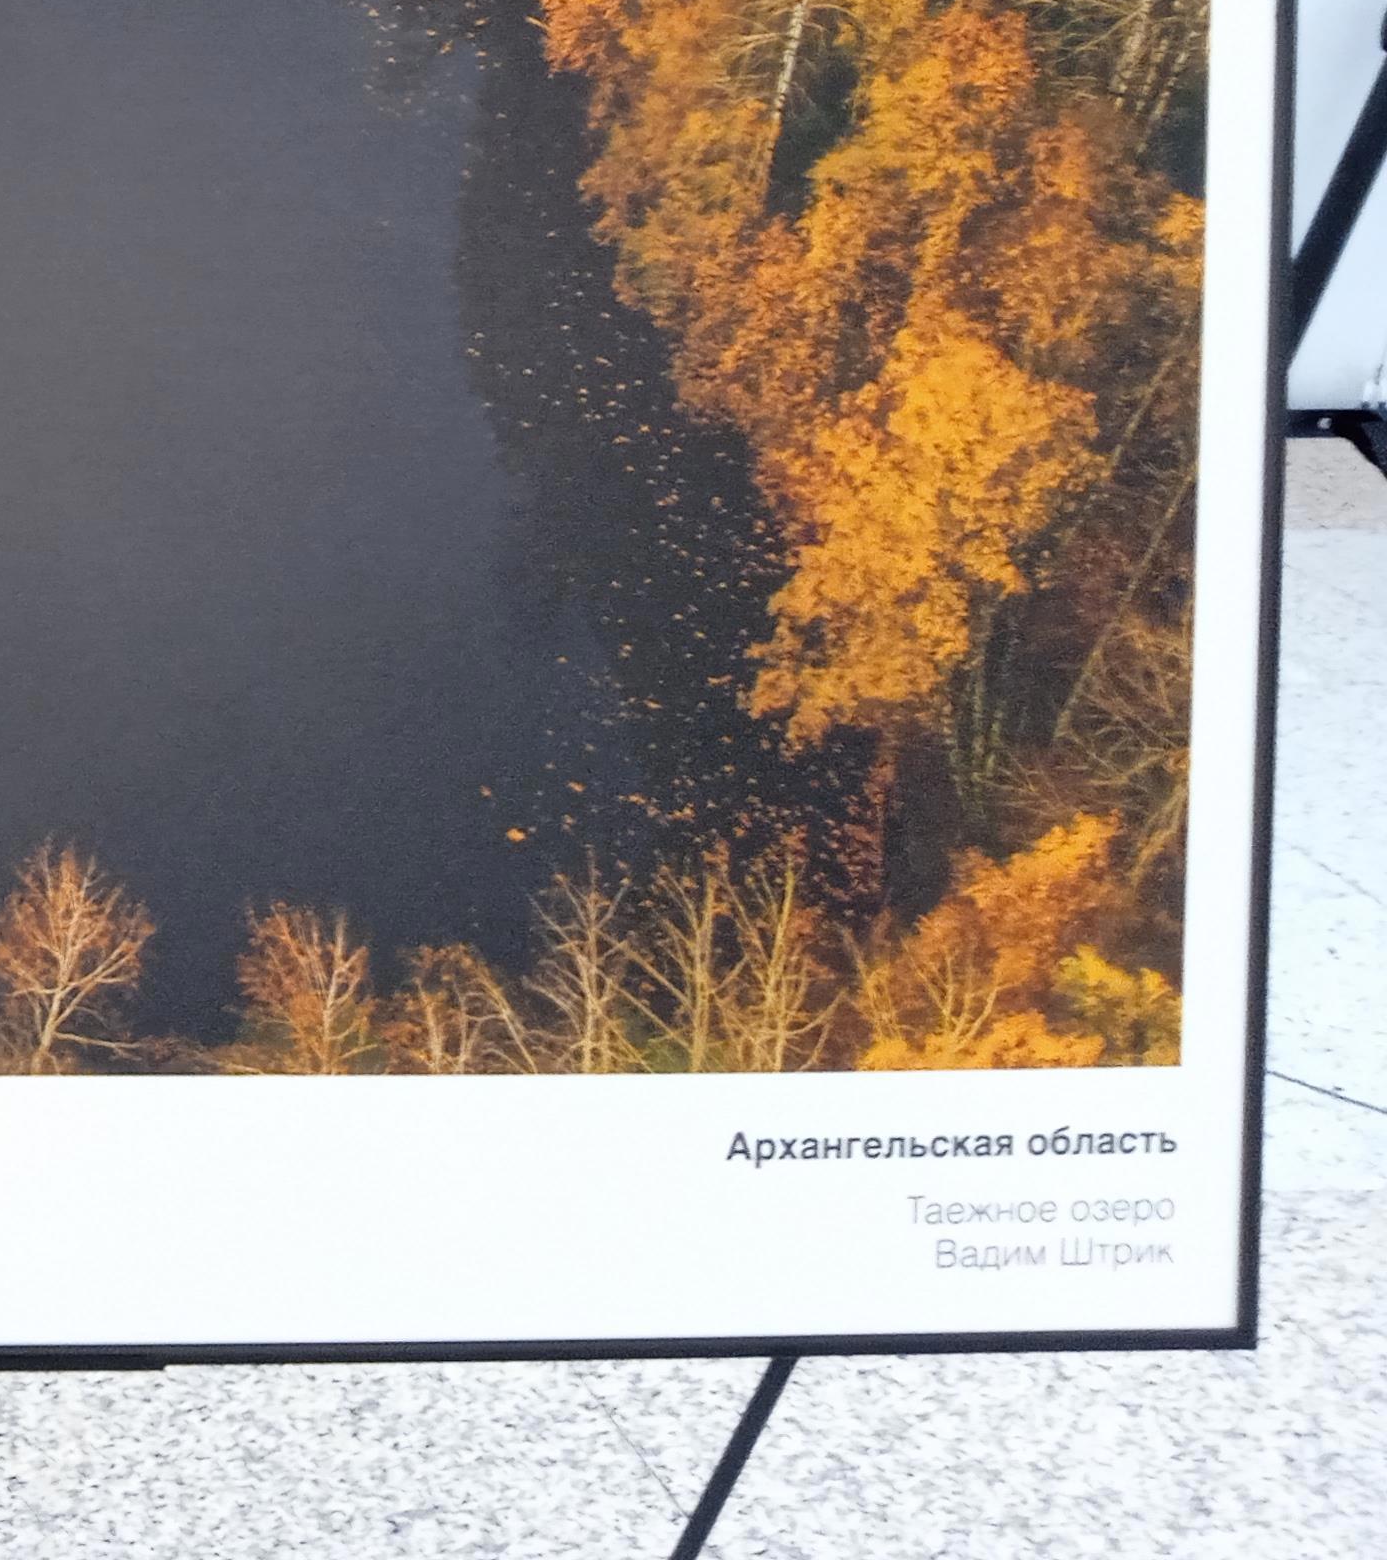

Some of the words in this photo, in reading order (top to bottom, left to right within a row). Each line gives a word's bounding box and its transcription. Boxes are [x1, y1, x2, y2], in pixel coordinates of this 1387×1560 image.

[726, 1131, 1014, 1168] Архангельская
[1028, 1126, 1178, 1156] область
[907, 1195, 1058, 1225] Таежное
[1070, 1197, 1175, 1227] озеро
[935, 1238, 1046, 1271] Вадим
[1060, 1238, 1174, 1271] Штрик
